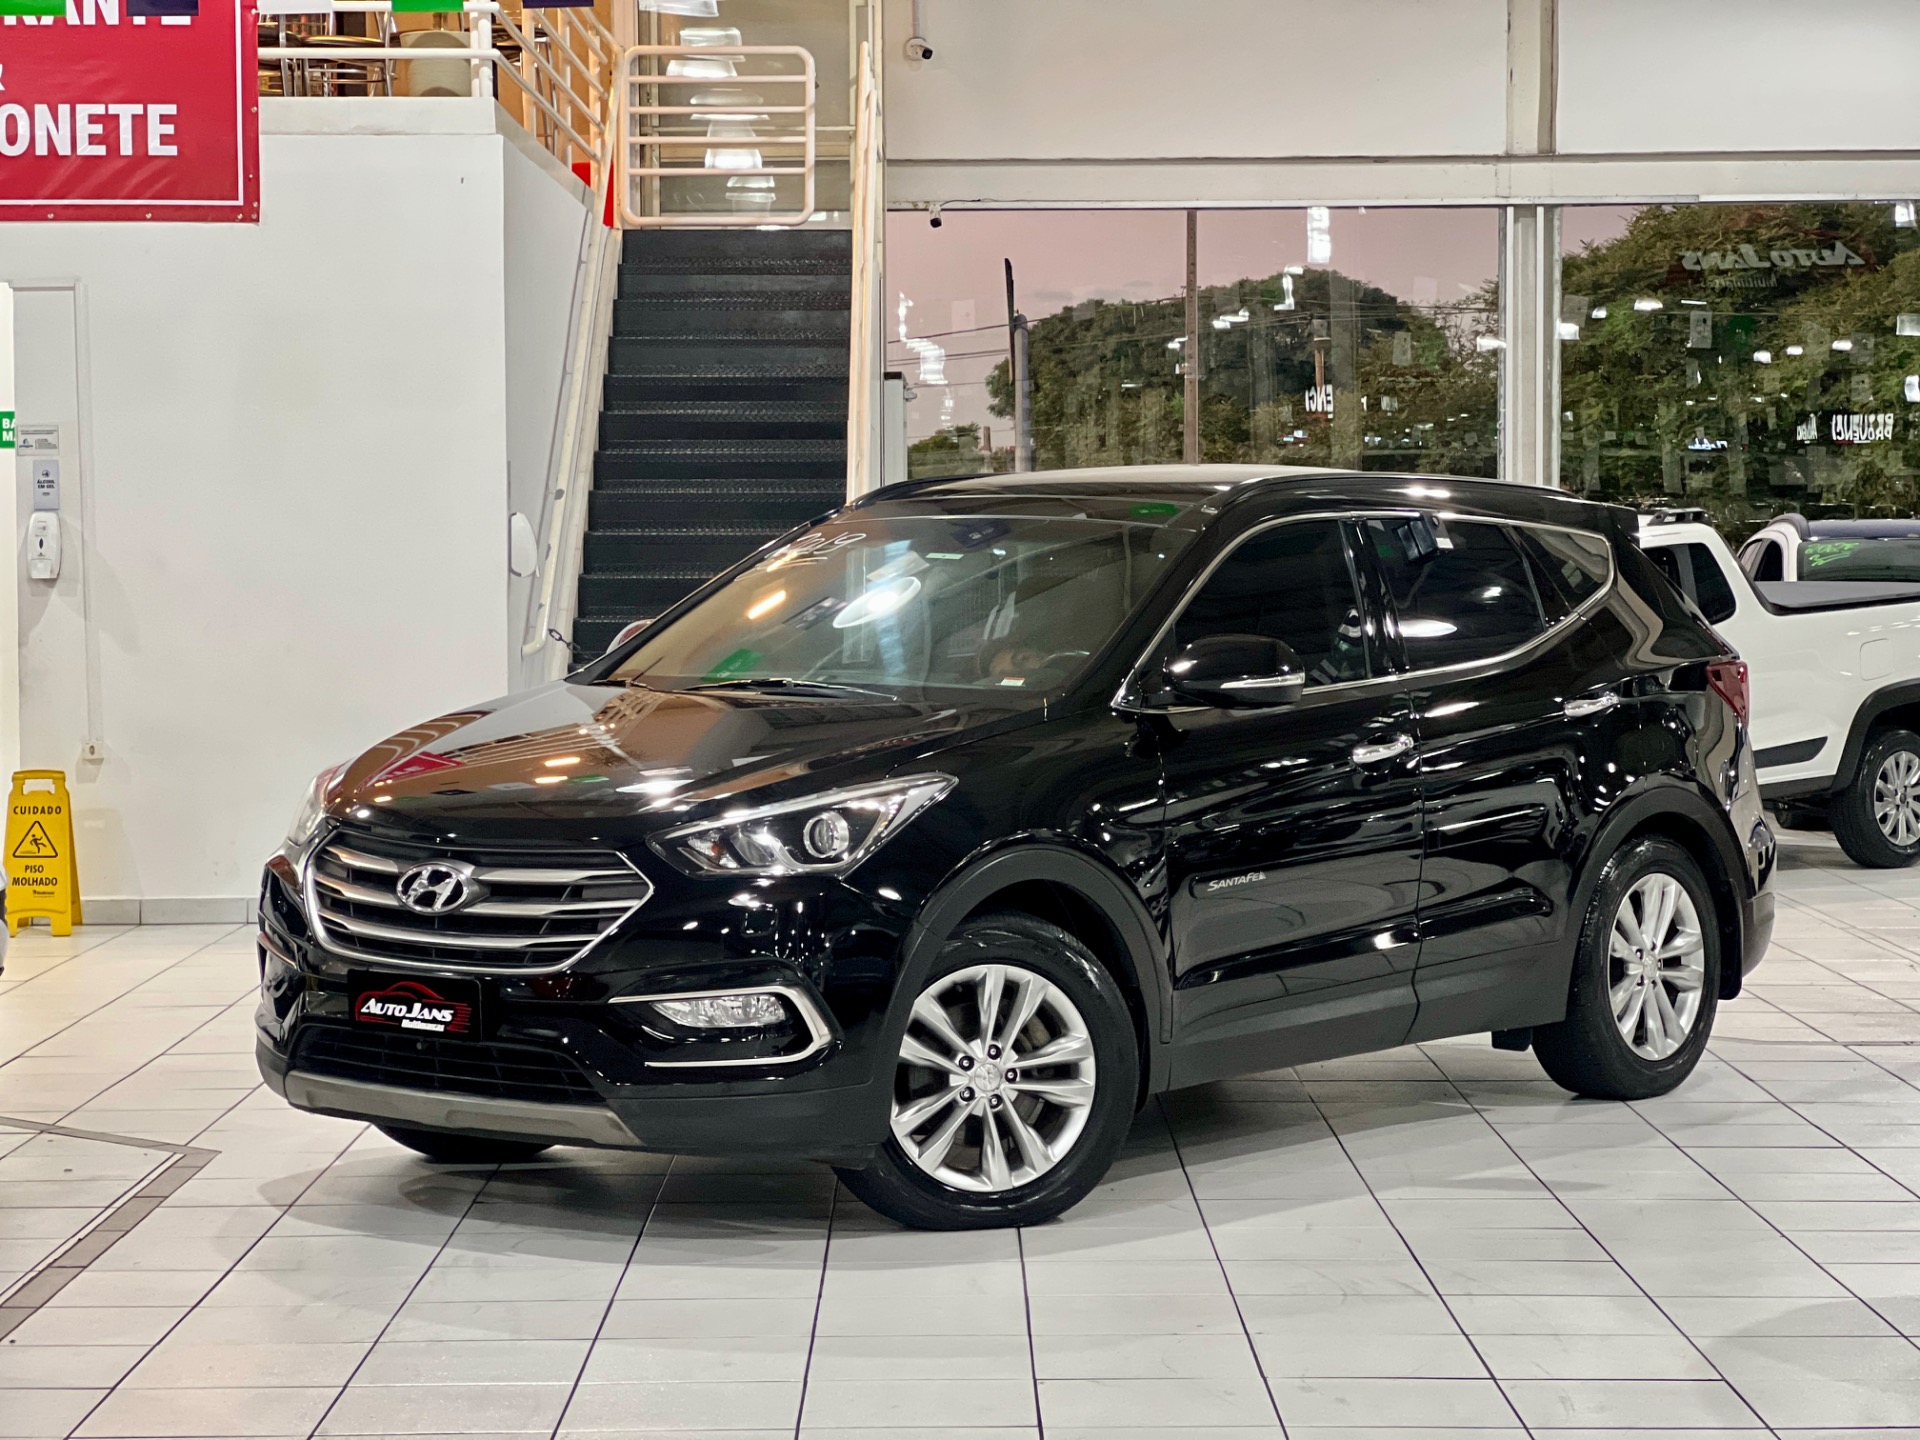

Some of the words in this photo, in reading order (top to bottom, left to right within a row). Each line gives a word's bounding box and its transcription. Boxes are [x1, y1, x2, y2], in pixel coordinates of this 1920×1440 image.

[0, 103, 178, 156] ONETE
[13, 805, 62, 815] CUIDADO
[25, 865, 44, 874] PISO
[12, 877, 58, 887] MOLHADO
